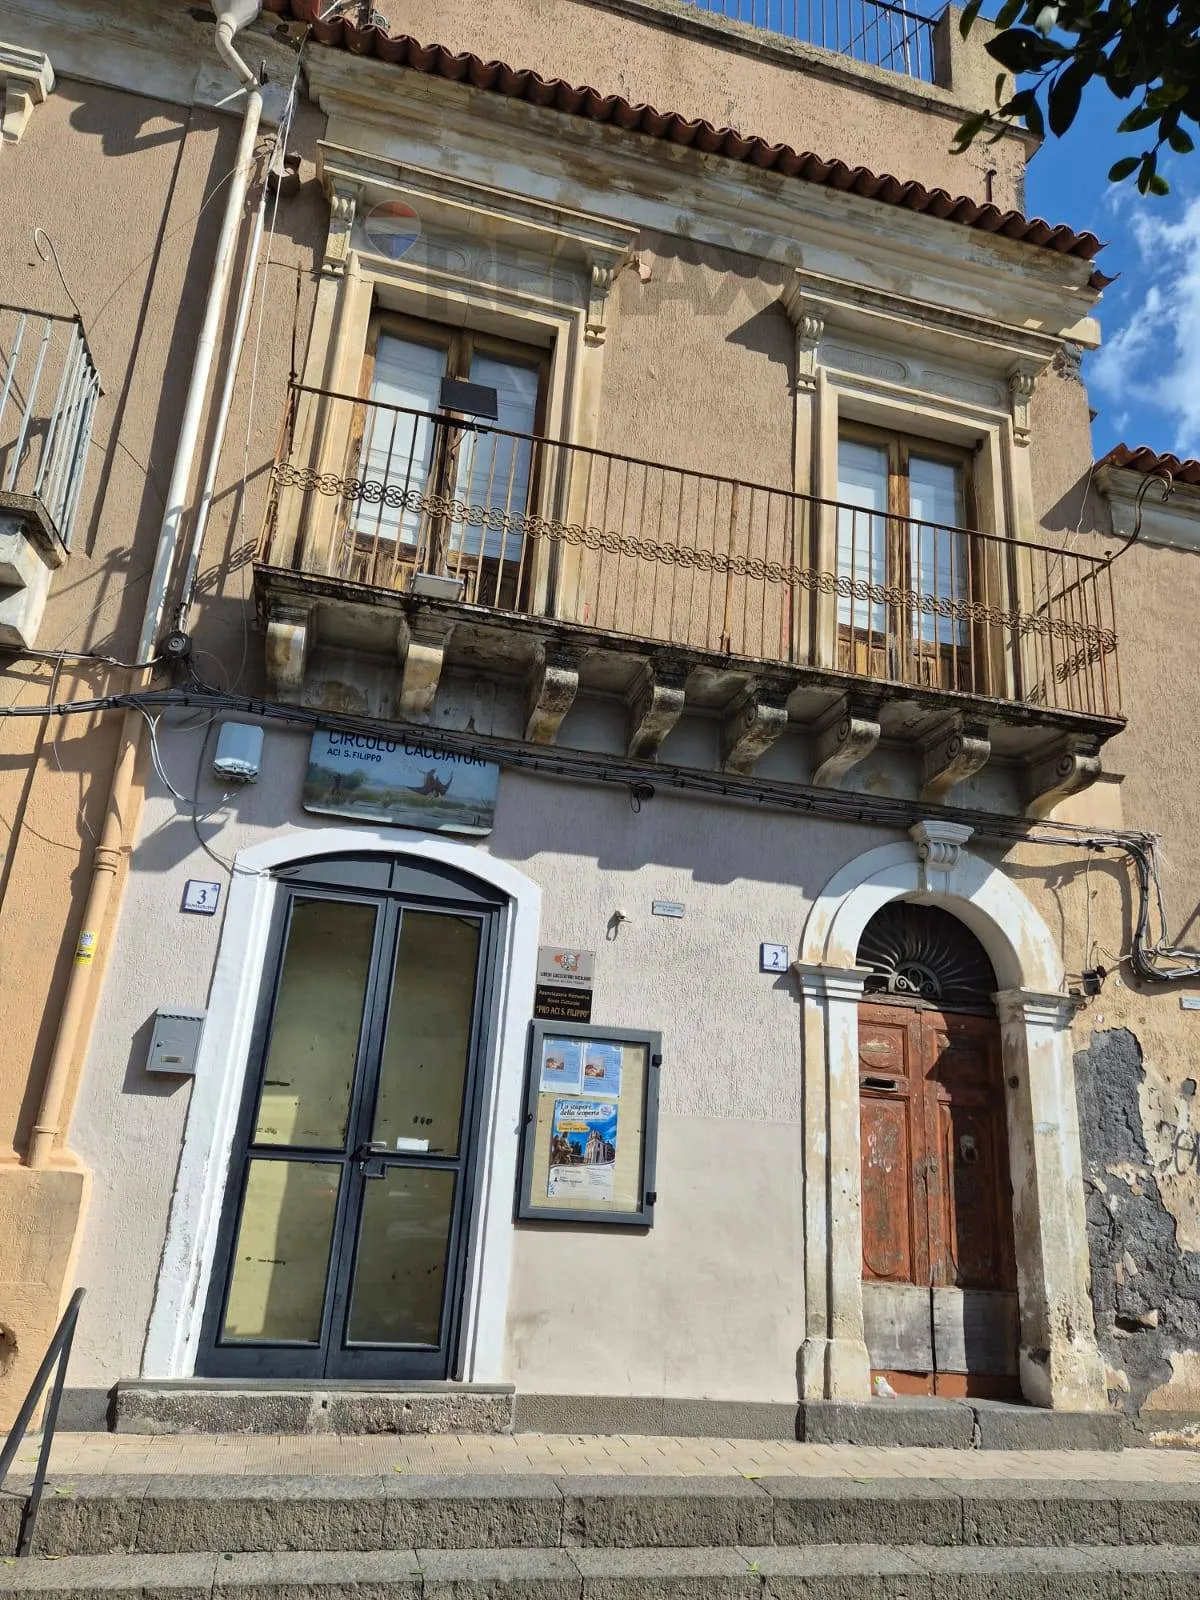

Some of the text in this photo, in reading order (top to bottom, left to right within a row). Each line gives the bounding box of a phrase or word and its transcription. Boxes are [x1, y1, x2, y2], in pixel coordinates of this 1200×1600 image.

[327, 747, 341, 757] ACI
[352, 751, 383, 763] FILIPPO
[196, 889, 207, 905] 3
[772, 951, 780, 966] 2
